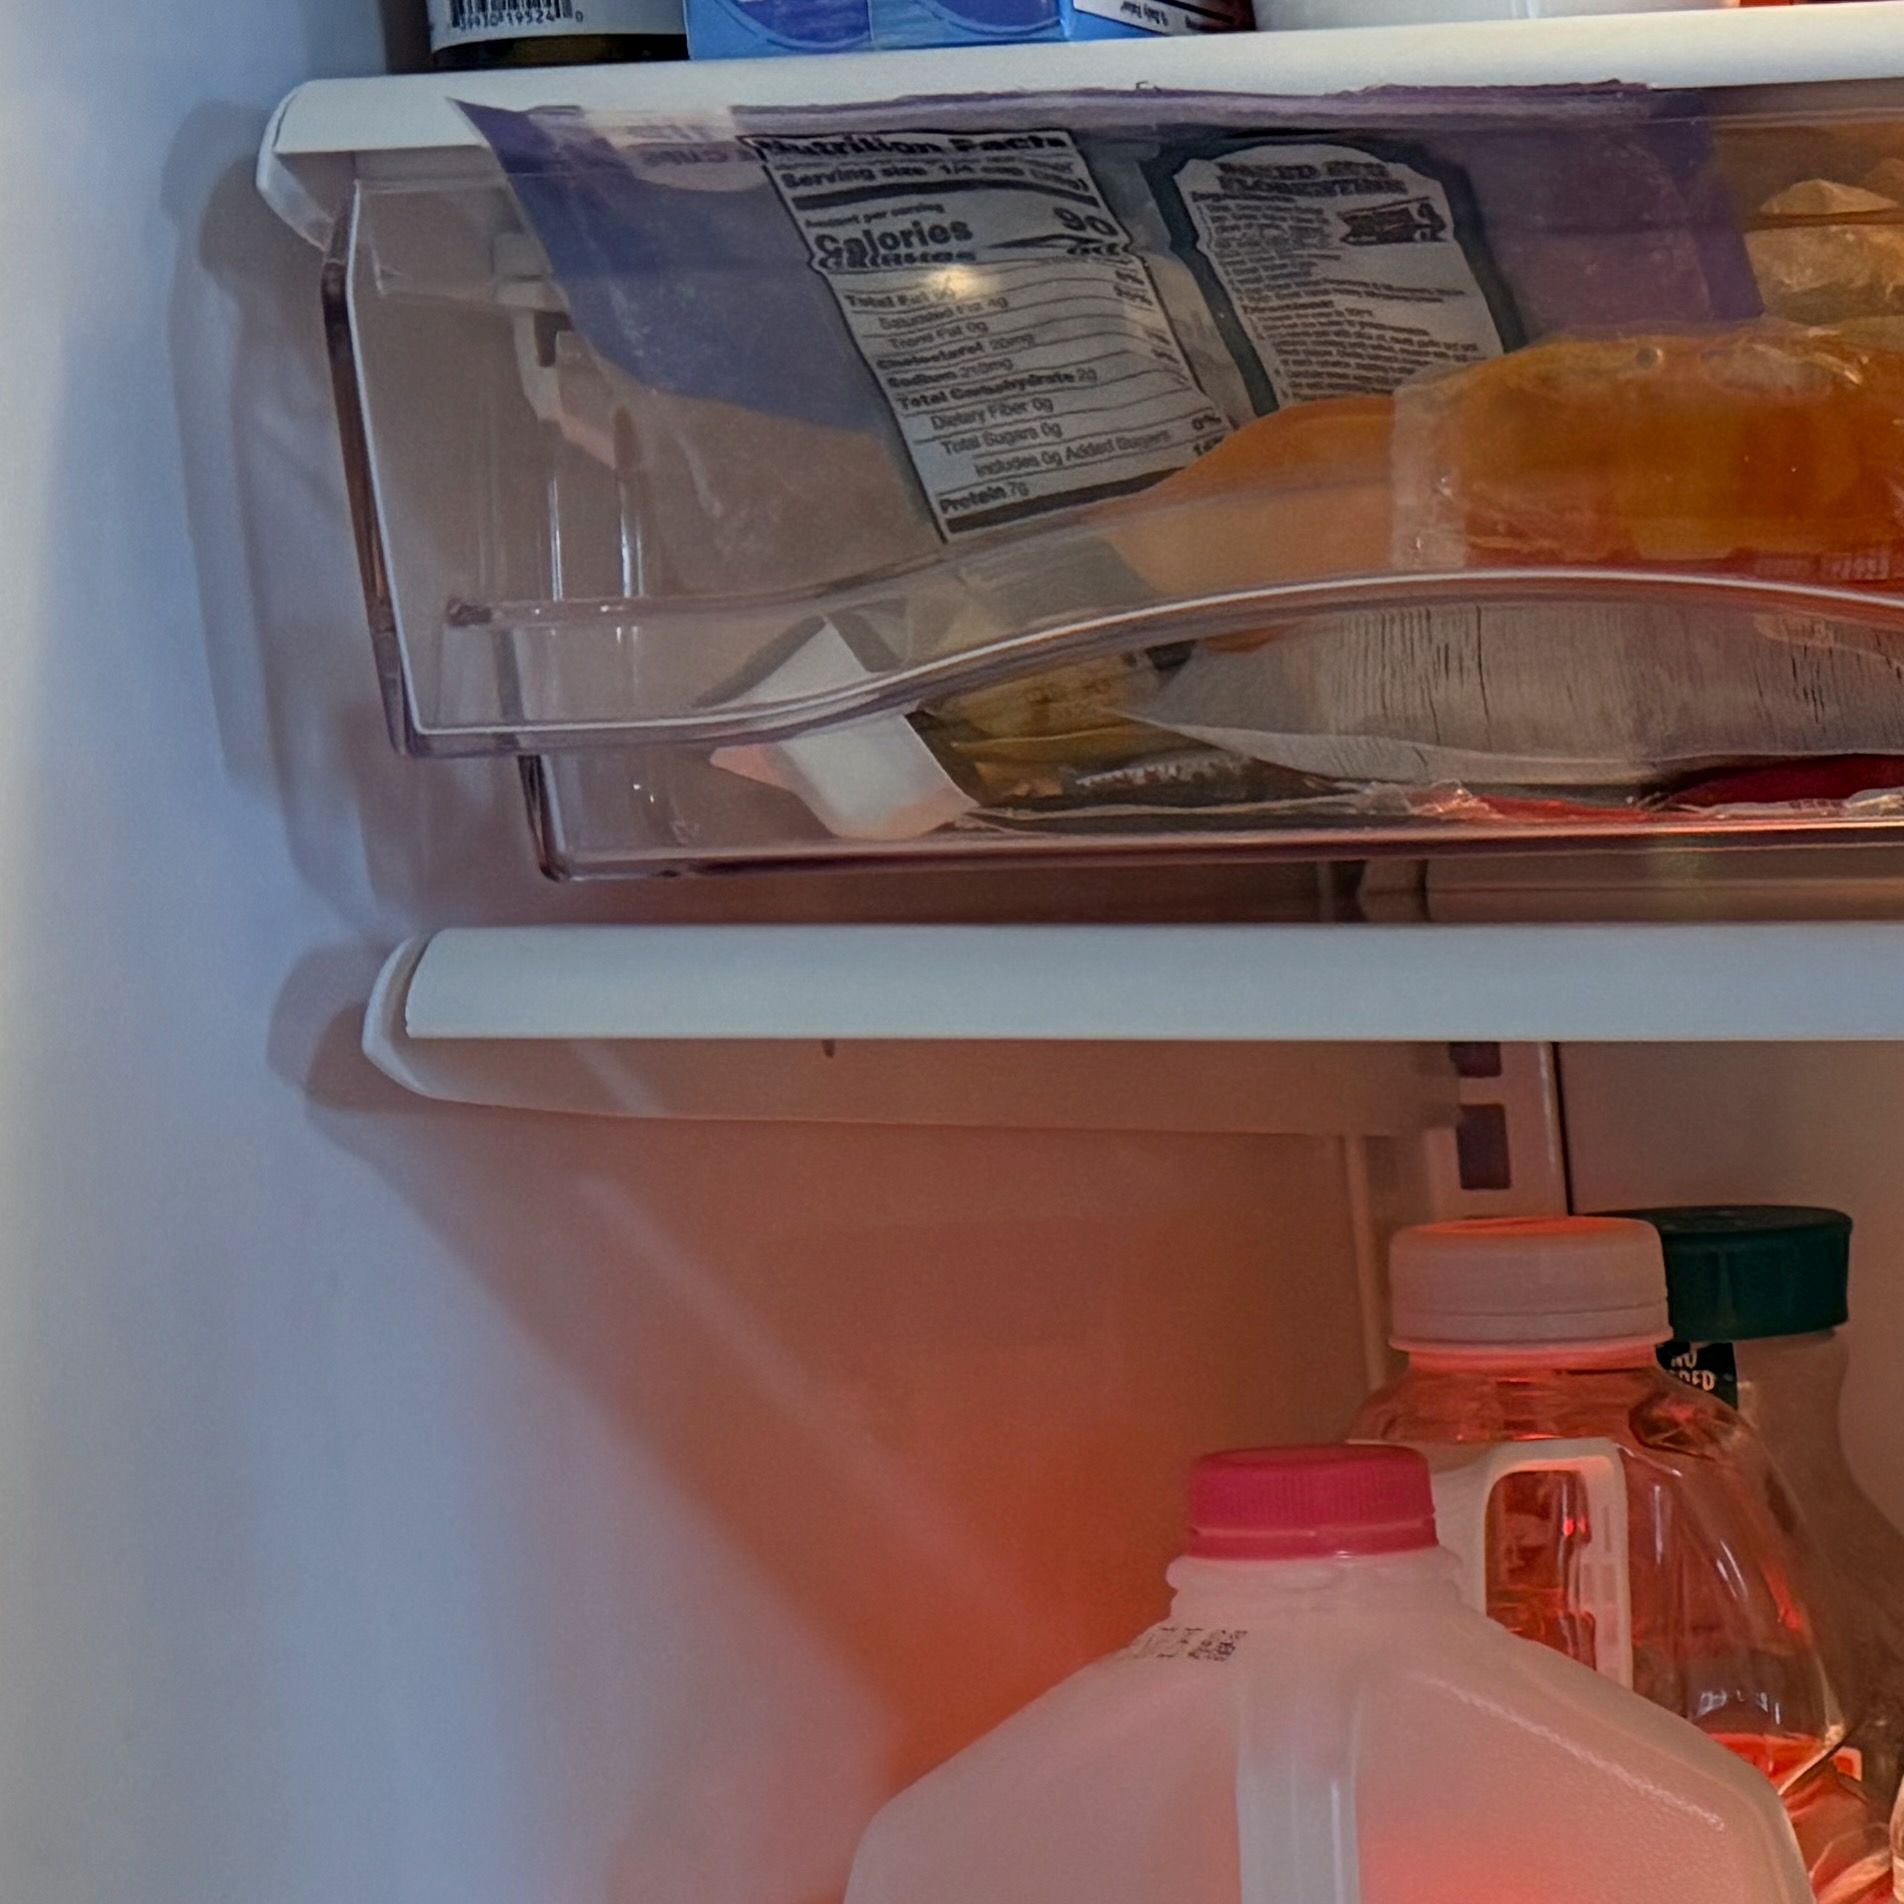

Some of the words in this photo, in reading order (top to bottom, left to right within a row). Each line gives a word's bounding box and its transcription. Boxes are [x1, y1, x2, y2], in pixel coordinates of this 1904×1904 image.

[753, 136, 943, 159] Nutrition
[950, 135, 1067, 153] Facts
[815, 218, 973, 254] Calories
[1053, 206, 1117, 236] 90
[899, 389, 947, 409] Total
[932, 408, 985, 430] Dietary
[989, 401, 1029, 419] Fiber
[941, 436, 981, 456] Total
[941, 485, 1006, 514] Protein
